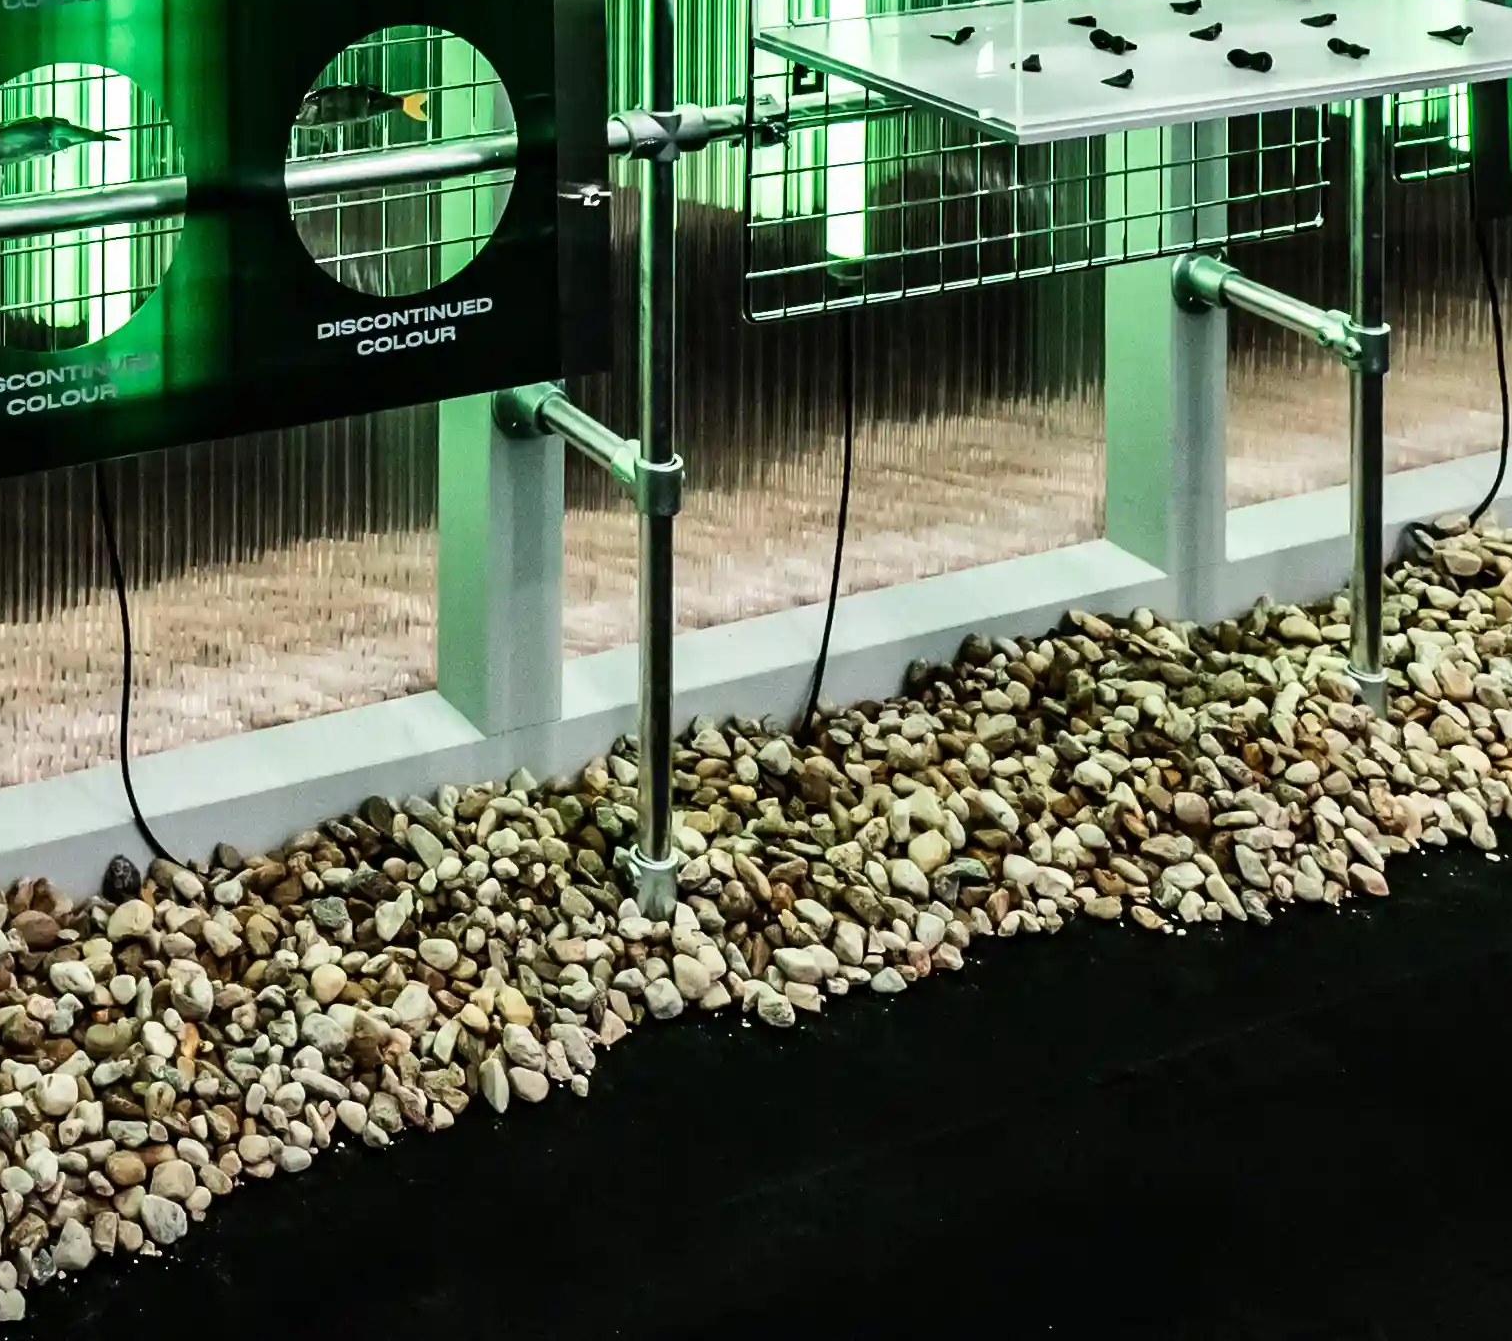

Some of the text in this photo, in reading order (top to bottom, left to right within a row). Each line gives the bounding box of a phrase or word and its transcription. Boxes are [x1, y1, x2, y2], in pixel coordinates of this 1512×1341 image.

[317, 297, 493, 340] DISCONTINUED
[357, 325, 457, 356] COLOUR
[6, 383, 119, 416] COLOUR
